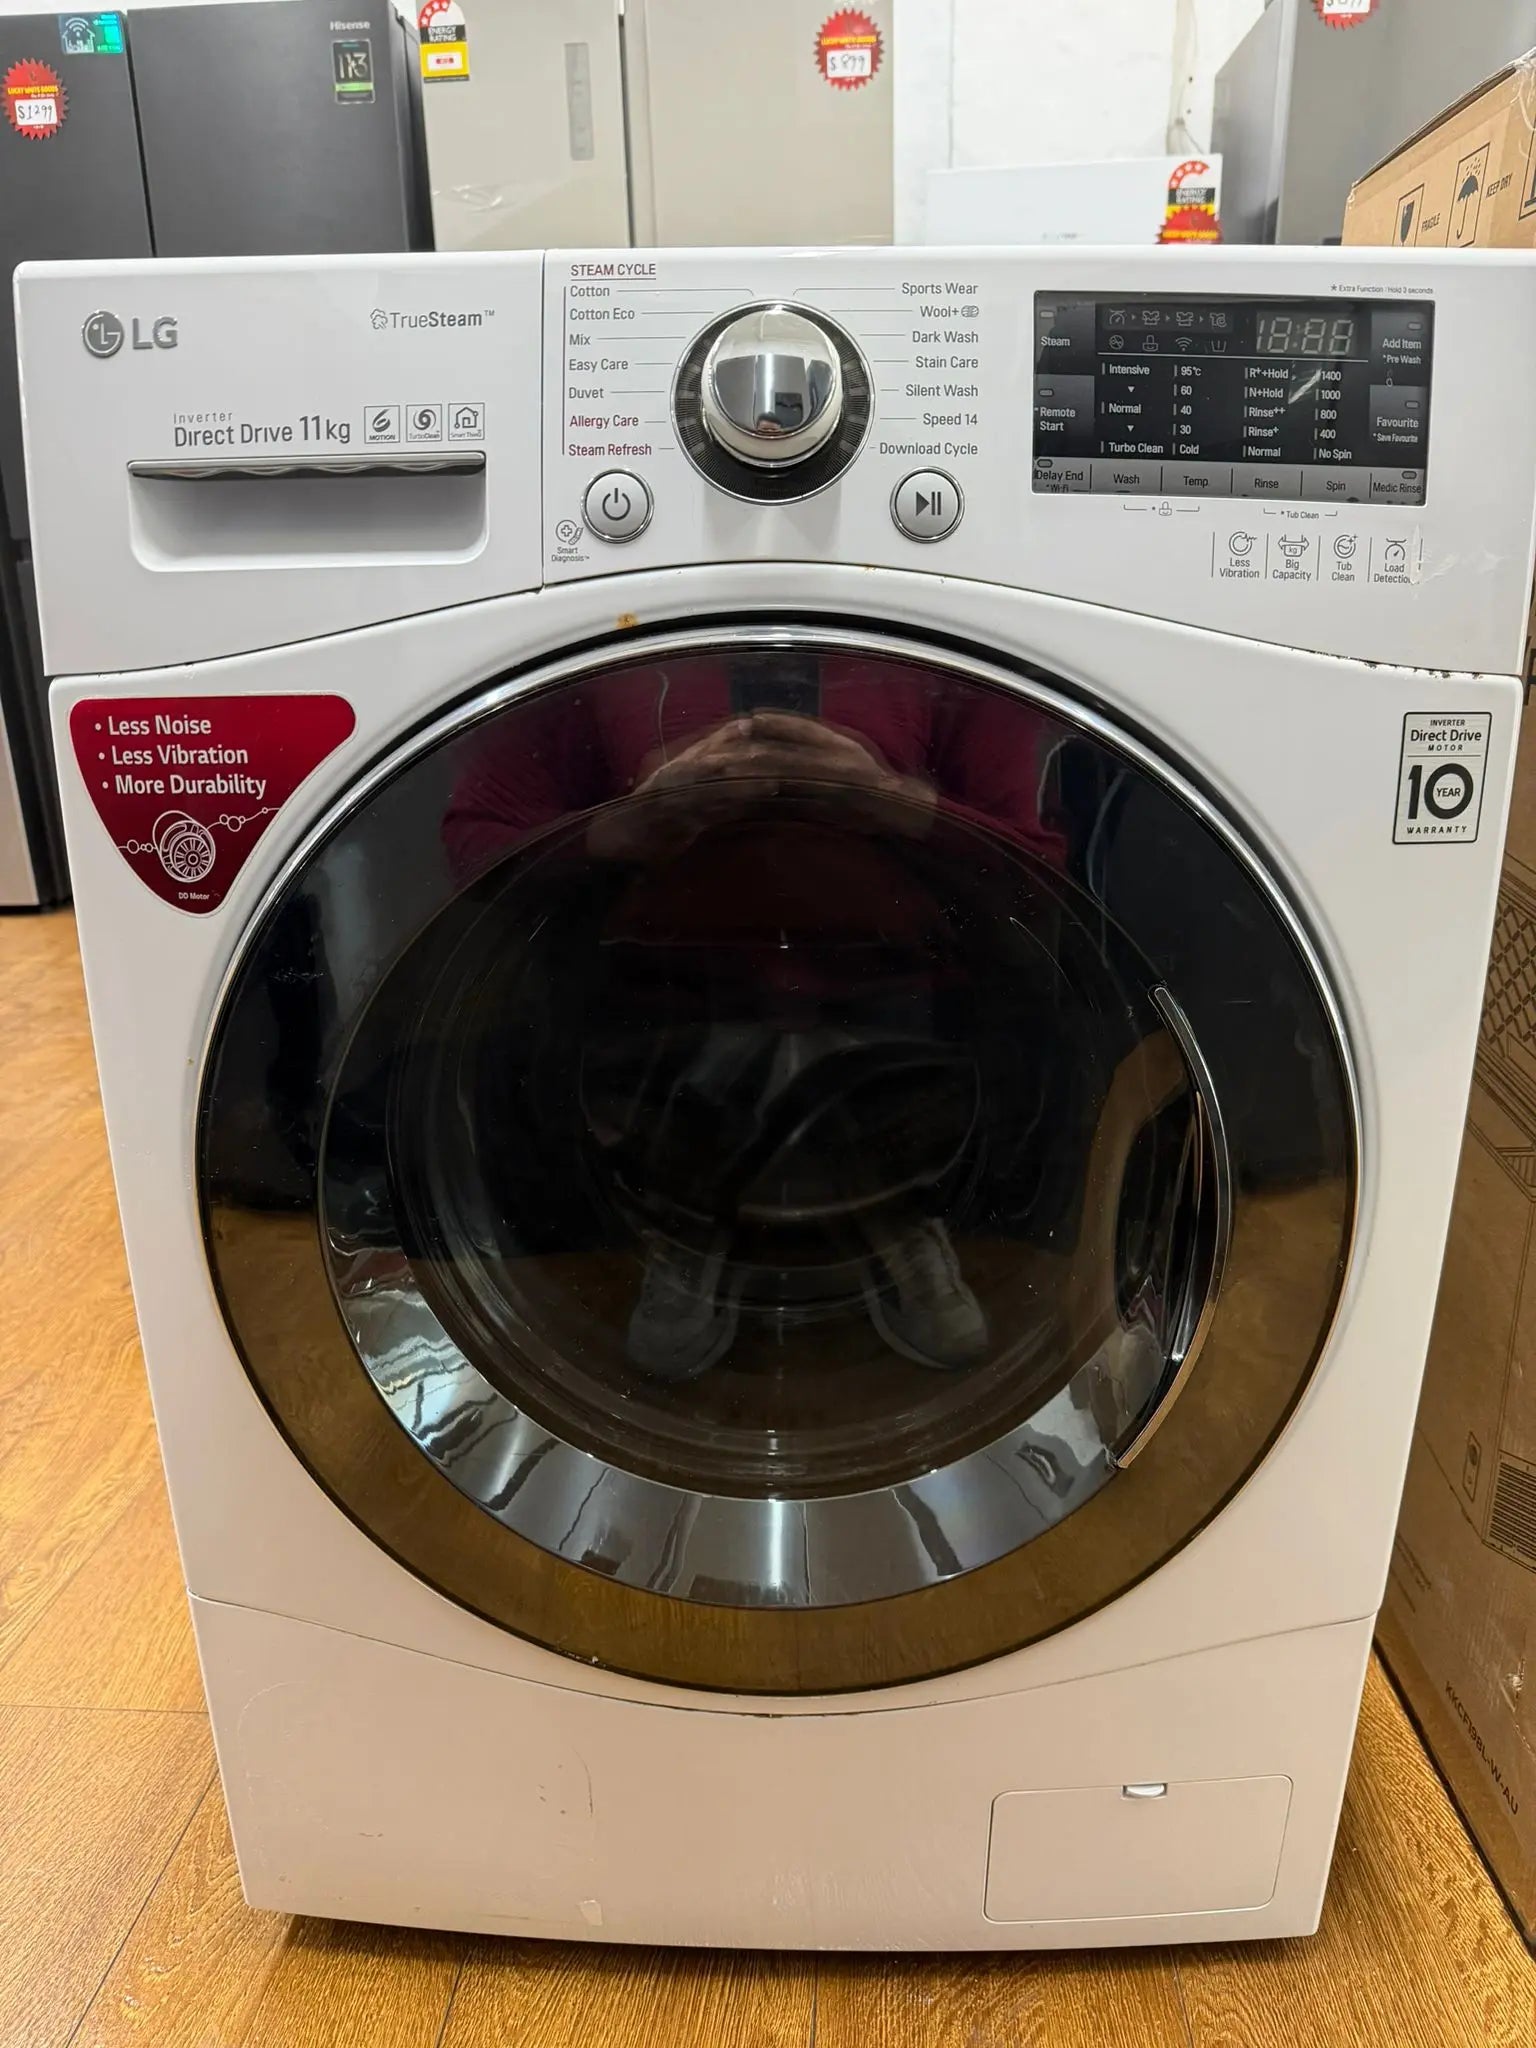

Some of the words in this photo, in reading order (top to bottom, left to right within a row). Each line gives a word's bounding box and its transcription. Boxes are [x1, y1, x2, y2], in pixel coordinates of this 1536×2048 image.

[330, 20, 370, 30] Hisense
[429, 26, 457, 34] ENERGY
[429, 34, 457, 42] RATING
[1486, 180, 1501, 198] KEEP
[1500, 172, 1513, 191] DRY
[1421, 212, 1441, 231] FRAGILE
[571, 264, 614, 276] STEAM
[617, 263, 656, 275] CYCLE
[570, 285, 610, 297] Cotton
[902, 282, 942, 296] Sports
[945, 282, 978, 294] Wear
[1339, 284, 1355, 292] Extra
[1357, 285, 1383, 293] Function
[570, 308, 610, 320] Cotton
[613, 307, 635, 320] Eco
[132, 316, 178, 350] LG
[912, 330, 941, 343] Dark
[944, 330, 979, 343] Wash
[569, 334, 591, 346] Mix
[1040, 335, 1071, 347] Steam
[1382, 338, 1400, 349] Add
[1402, 338, 1422, 349] Item
[915, 355, 947, 368] Stain
[950, 356, 979, 368] Care
[1400, 355, 1421, 365] Wash
[569, 359, 597, 373] Easy
[600, 359, 629, 371] Care
[1109, 363, 1150, 376] Intensive
[1322, 371, 1342, 381] 1400
[568, 386, 604, 399] Duvet
[905, 384, 941, 397] Silent
[943, 384, 978, 397] Wash
[1180, 385, 1192, 396] 60
[1249, 387, 1284, 399] N+Hold
[1321, 390, 1341, 400] 1000
[1040, 407, 1076, 418] Remote
[1108, 403, 1141, 414] Normal
[1180, 405, 1192, 415] 40
[173, 412, 233, 424] Inverter
[923, 413, 961, 427] Speed
[965, 414, 978, 425] 14
[1320, 410, 1337, 420] 800
[570, 416, 609, 429] Allergy
[612, 415, 639, 427] Care
[1040, 421, 1064, 431] Start
[1376, 417, 1419, 428] Favourite
[174, 426, 235, 447] Direct
[240, 423, 293, 444] Drive
[1180, 425, 1192, 435] 30
[1248, 427, 1279, 438] Rinse+
[1319, 429, 1336, 439] 400
[1377, 433, 1391, 442] Save
[1392, 433, 1418, 443] Favourite
[568, 444, 605, 456] Steam
[607, 443, 652, 456] Refresh
[880, 442, 941, 455] Download
[944, 442, 978, 457] Cycle
[1108, 442, 1136, 453] Turbo
[1137, 443, 1164, 454] Clean
[1179, 444, 1200, 455] Cold
[1247, 447, 1281, 458] Normal
[1318, 449, 1332, 459] No
[1333, 449, 1352, 461] Spin
[1036, 470, 1063, 481] Delay
[1065, 470, 1084, 481] End
[1113, 474, 1140, 484] Wash
[1183, 476, 1209, 488] Temp
[1254, 478, 1280, 489] Rinse
[1326, 482, 1346, 492] Spin
[1373, 482, 1398, 493] Medic
[1400, 483, 1422, 494] Rinse
[1286, 510, 1299, 518] Tub
[1300, 511, 1319, 519] Clean
[1230, 558, 1250, 567] Less
[1285, 559, 1300, 570] Big
[1336, 561, 1352, 571] Tub
[1384, 563, 1405, 573] Load
[1219, 568, 1260, 578] Vibration
[1272, 569, 1312, 582] Capacity
[1331, 572, 1355, 582] Clean
[108, 715, 150, 735] Less
[155, 714, 212, 734] Noise
[1430, 719, 1466, 727] INVERTER
[1410, 729, 1448, 742] Direct
[1450, 729, 1482, 742] Drive
[1428, 744, 1464, 752] MOTOR
[112, 745, 153, 765] Less
[157, 744, 249, 764] Vibration
[115, 774, 166, 794] More
[170, 774, 267, 800] Durability
[1408, 763, 1474, 820] 10
[1436, 787, 1461, 798] YEAR
[1407, 826, 1467, 834] WARRANTY
[178, 892, 189, 900] DD
[190, 892, 210, 900] Motor
